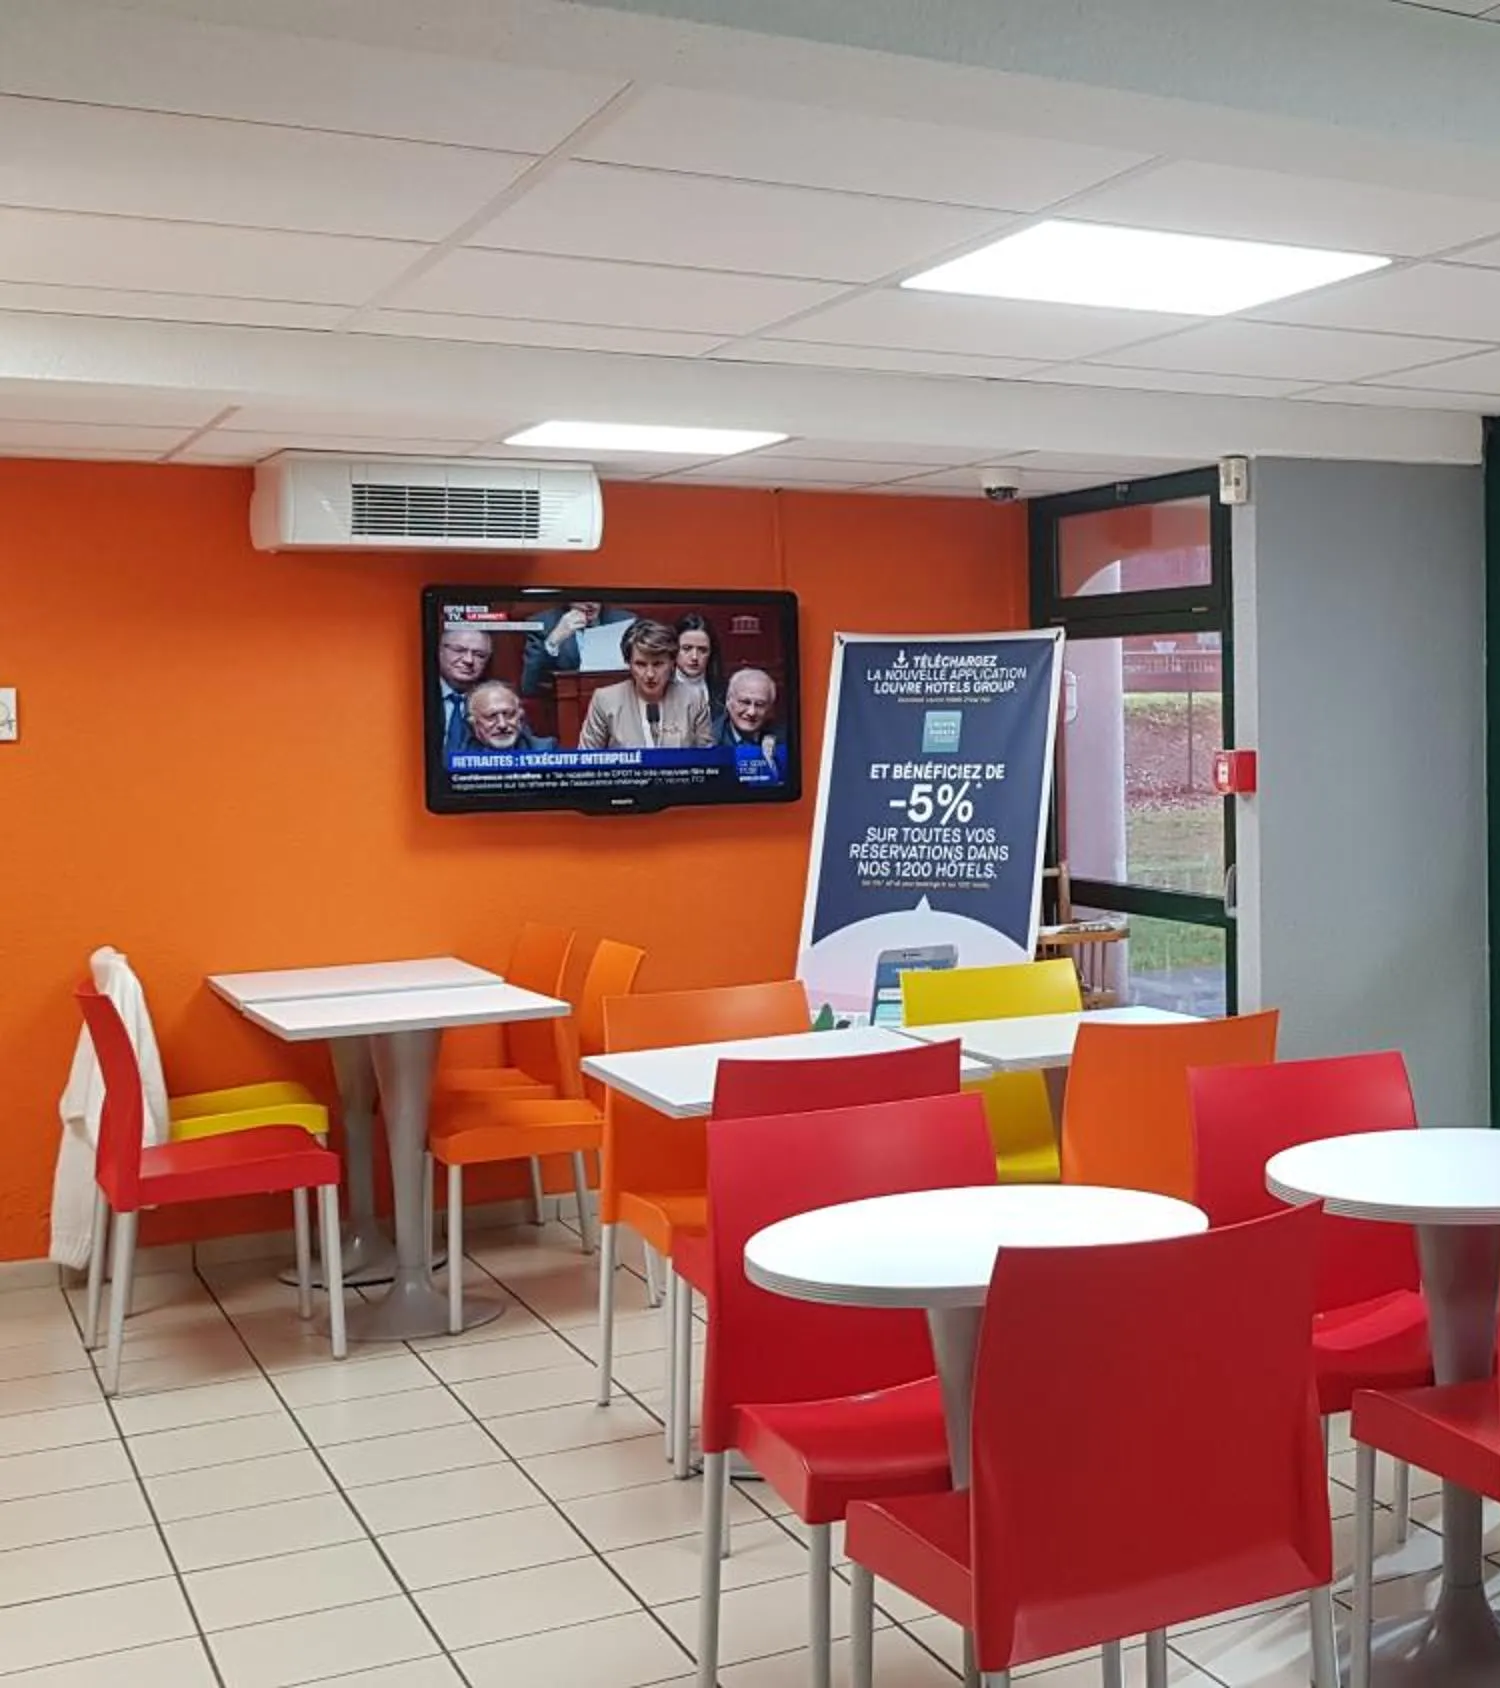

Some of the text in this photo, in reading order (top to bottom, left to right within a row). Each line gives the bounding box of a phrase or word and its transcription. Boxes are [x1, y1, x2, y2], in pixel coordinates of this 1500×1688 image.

[913, 653, 998, 668] TÉLÉCHARGEZ
[867, 667, 1027, 681] LA NOUVELLE APPLICATION
[874, 682, 921, 694] LOUVRE
[925, 682, 971, 694] HOTELS
[452, 755, 513, 768] RETRAITES
[580, 750, 641, 765] INTERPELLÉ
[870, 761, 1005, 779] ET BÉNÉFICIEZ DE
[866, 827, 996, 843] SUR TOUTES VOS
[849, 841, 1009, 861] RÉSERVATIONS DANS
[857, 859, 997, 879] NOS 1200 HÔTELS.
